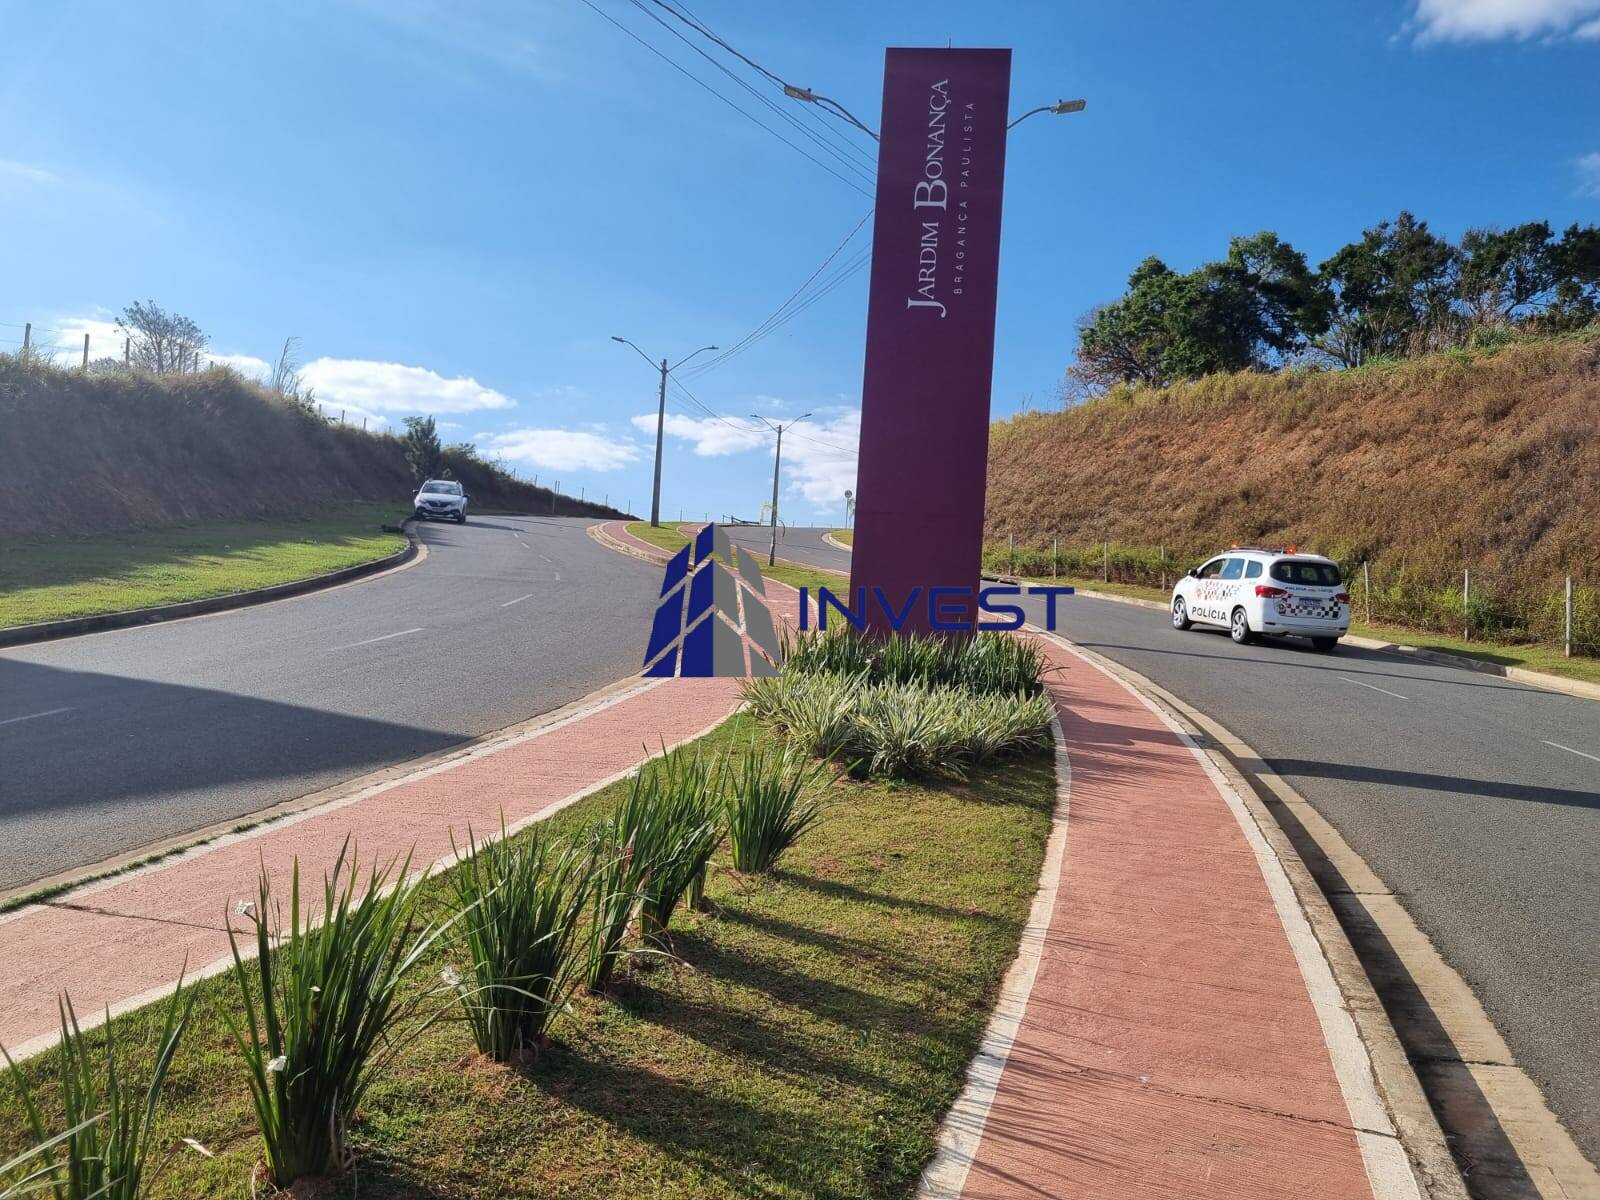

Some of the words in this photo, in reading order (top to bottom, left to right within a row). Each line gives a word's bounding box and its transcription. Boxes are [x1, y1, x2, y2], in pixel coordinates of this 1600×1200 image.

[913, 79, 951, 210] BONANÇA
[960, 103, 974, 188] PAULISTA
[907, 222, 947, 318] JARDIM
[953, 201, 968, 295] BRAGANÇA
[1192, 606, 1227, 621] POLÍCIA
